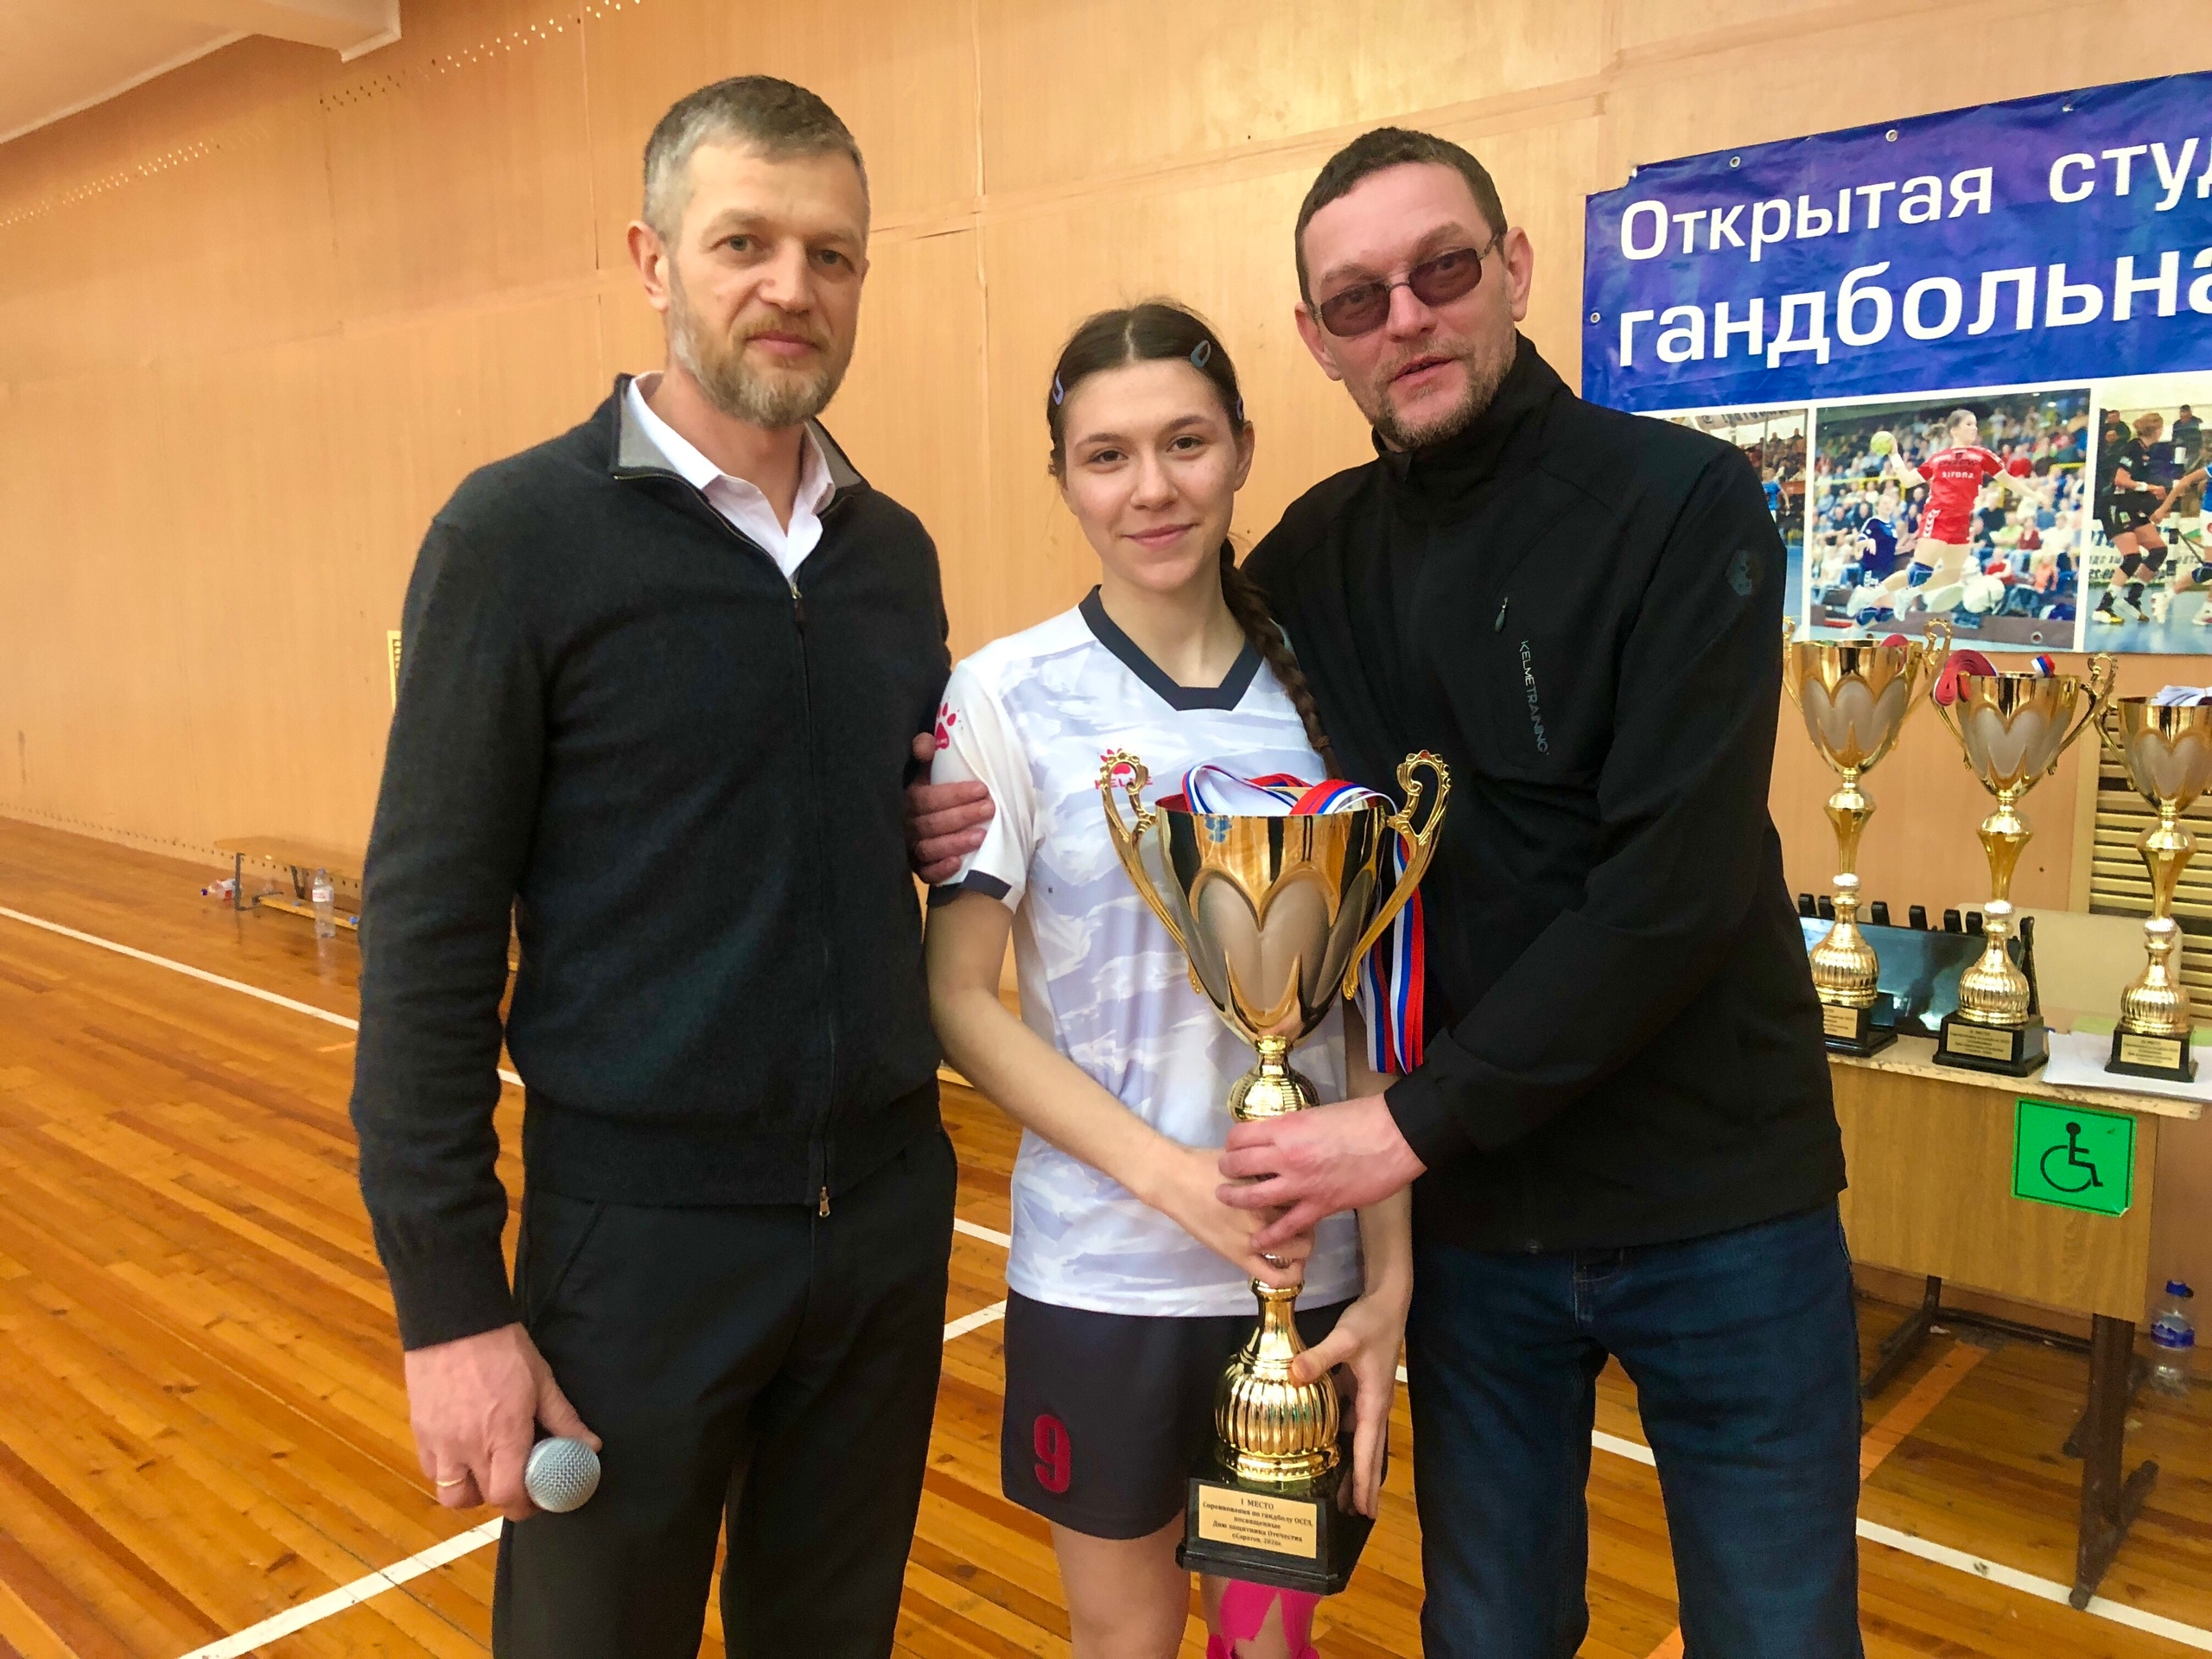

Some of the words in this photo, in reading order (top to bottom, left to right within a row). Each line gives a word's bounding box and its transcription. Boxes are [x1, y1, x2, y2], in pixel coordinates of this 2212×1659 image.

[1619, 166, 1993, 262] Открытая
[1034, 1414, 1071, 1494] 9
[1247, 1499, 1274, 1510] МЕСТО
[1262, 1513, 1294, 1523] гандболу
